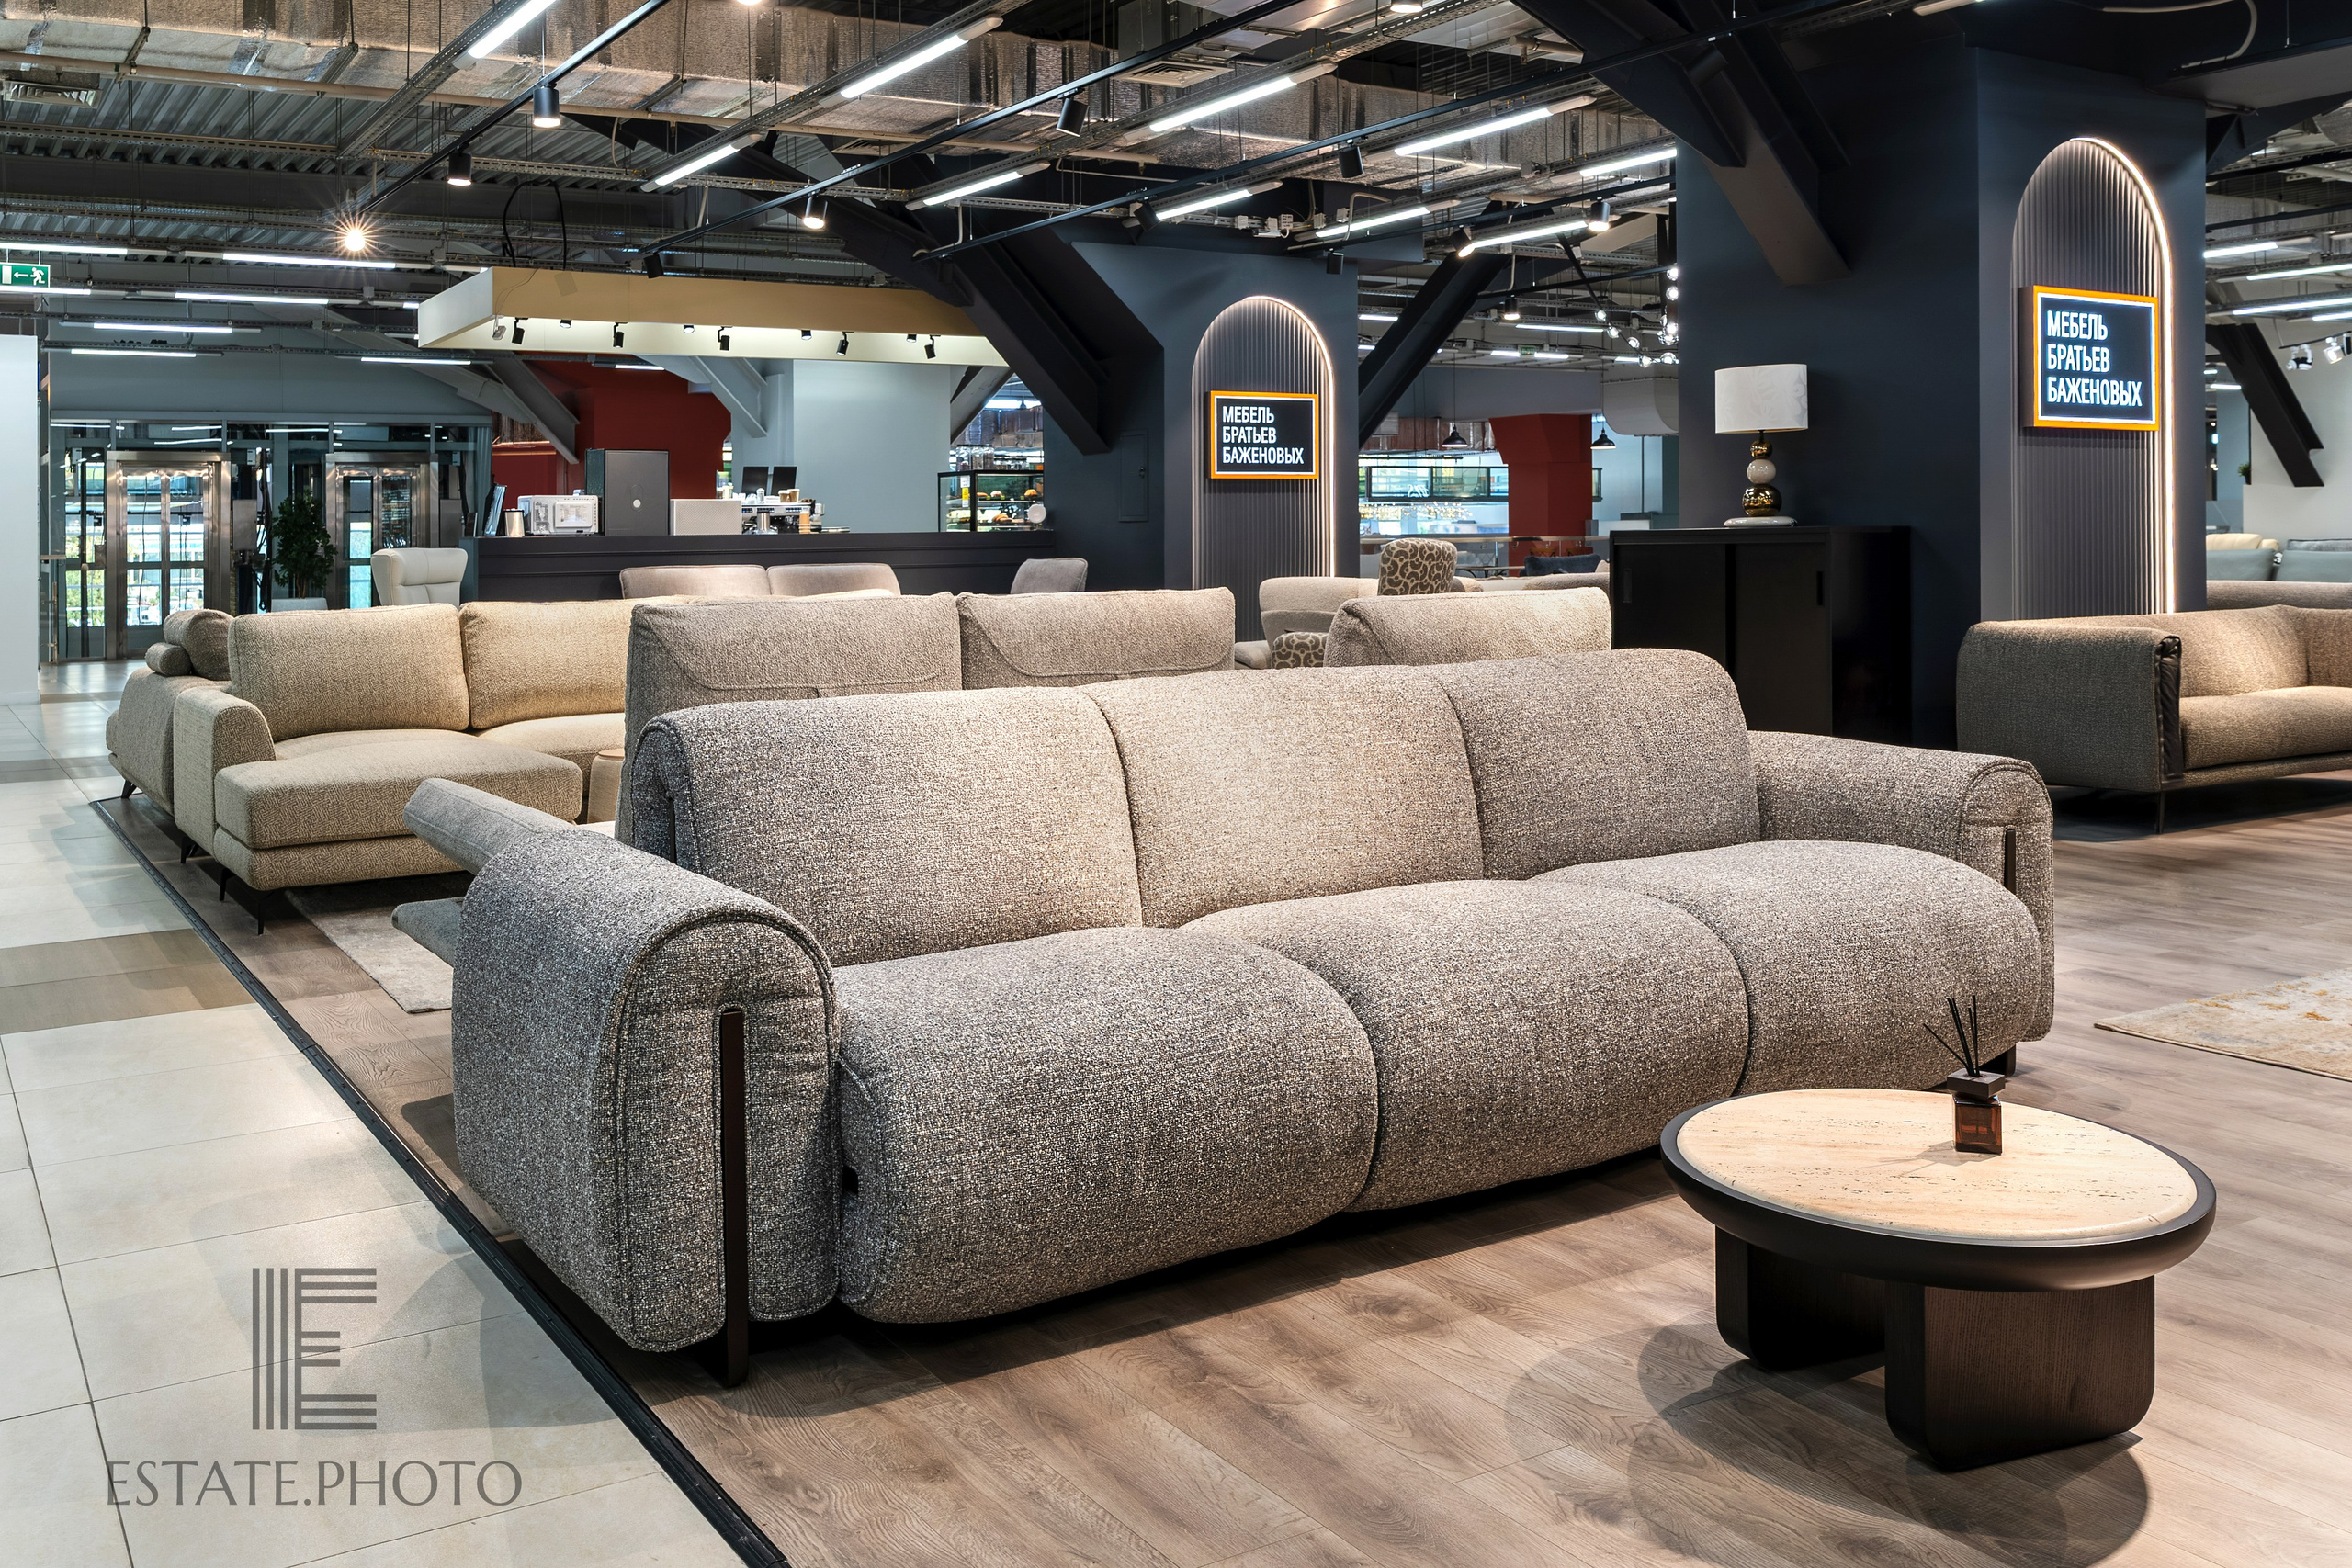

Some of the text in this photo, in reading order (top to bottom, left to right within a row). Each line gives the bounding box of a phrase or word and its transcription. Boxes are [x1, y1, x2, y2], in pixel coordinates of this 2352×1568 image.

[2047, 310, 2109, 340] МЕБЕЛЬ
[2047, 344, 2110, 373] БРАТЬЕВ
[2047, 377, 2143, 407] БАЖЕНОВЫХ
[1222, 405, 1275, 423] МЕБЕЛЬ
[1222, 425, 1277, 444] БРАТЬЕВ
[1222, 446, 1305, 464] БАЖЕНОВЫХ
